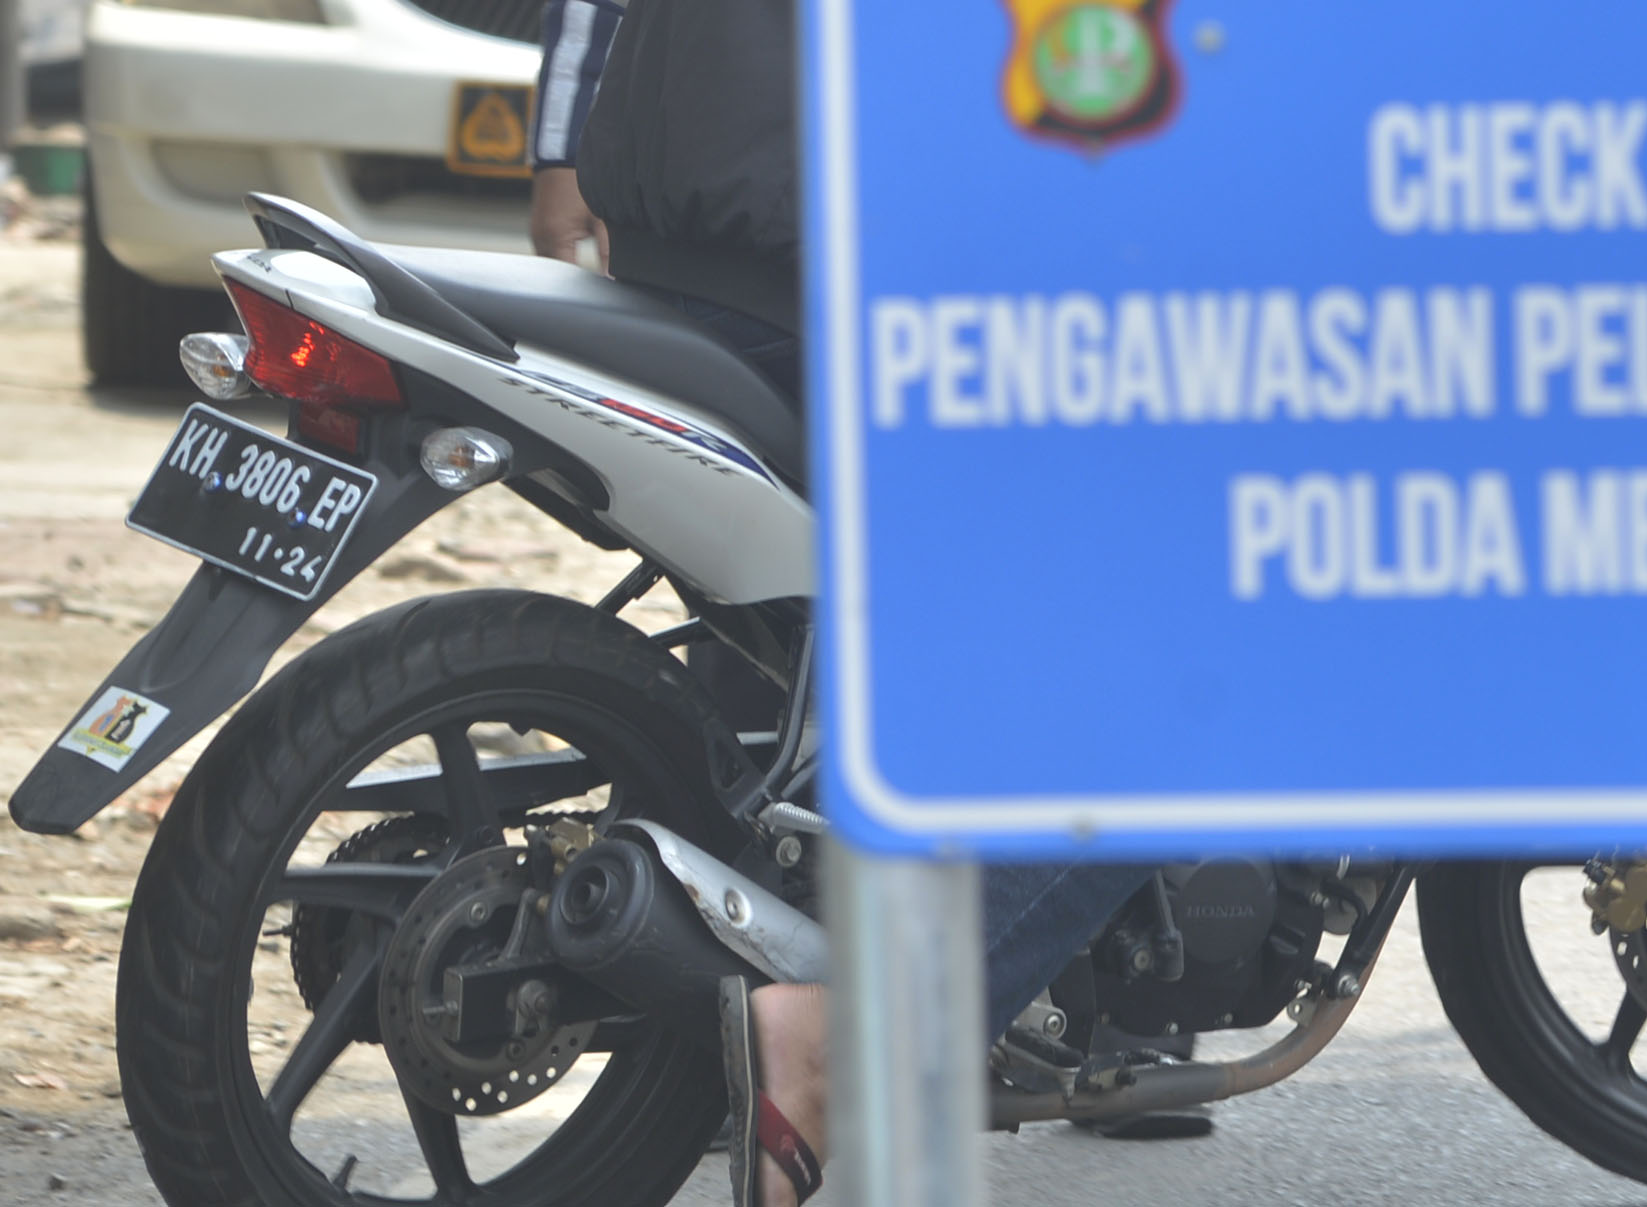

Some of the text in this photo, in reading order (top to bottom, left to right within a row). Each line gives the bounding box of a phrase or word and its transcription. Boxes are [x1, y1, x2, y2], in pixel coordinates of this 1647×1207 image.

[871, 284, 1494, 429] PENGAWASAN
[168, 418, 361, 532] KH 3806 EP
[1228, 468, 1525, 601] POLDA
[1187, 903, 1256, 920] HONDA
